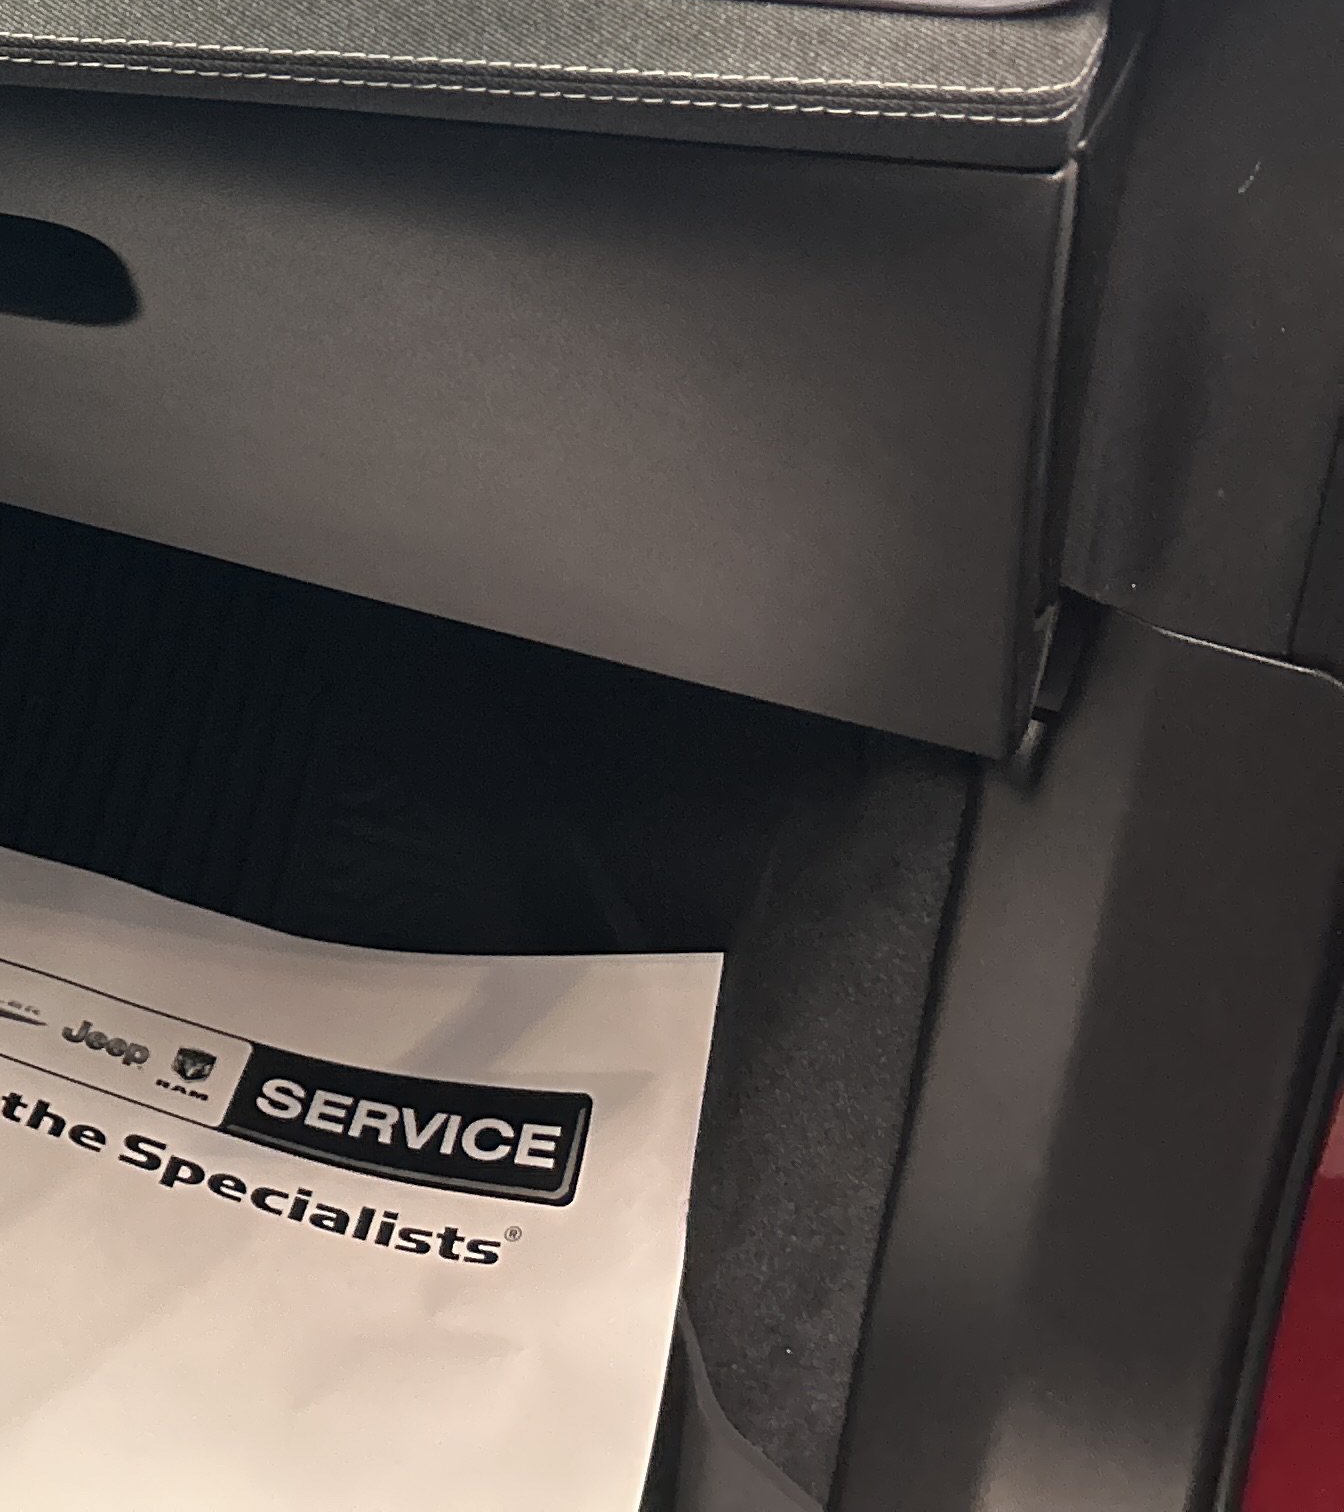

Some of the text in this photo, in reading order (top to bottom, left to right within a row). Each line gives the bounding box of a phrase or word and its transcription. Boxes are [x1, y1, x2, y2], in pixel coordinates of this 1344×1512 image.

[61, 1020, 150, 1066] Jeep
[156, 1079, 209, 1101] RAM
[1, 1092, 106, 1152] the
[255, 1078, 562, 1170] SERVICE
